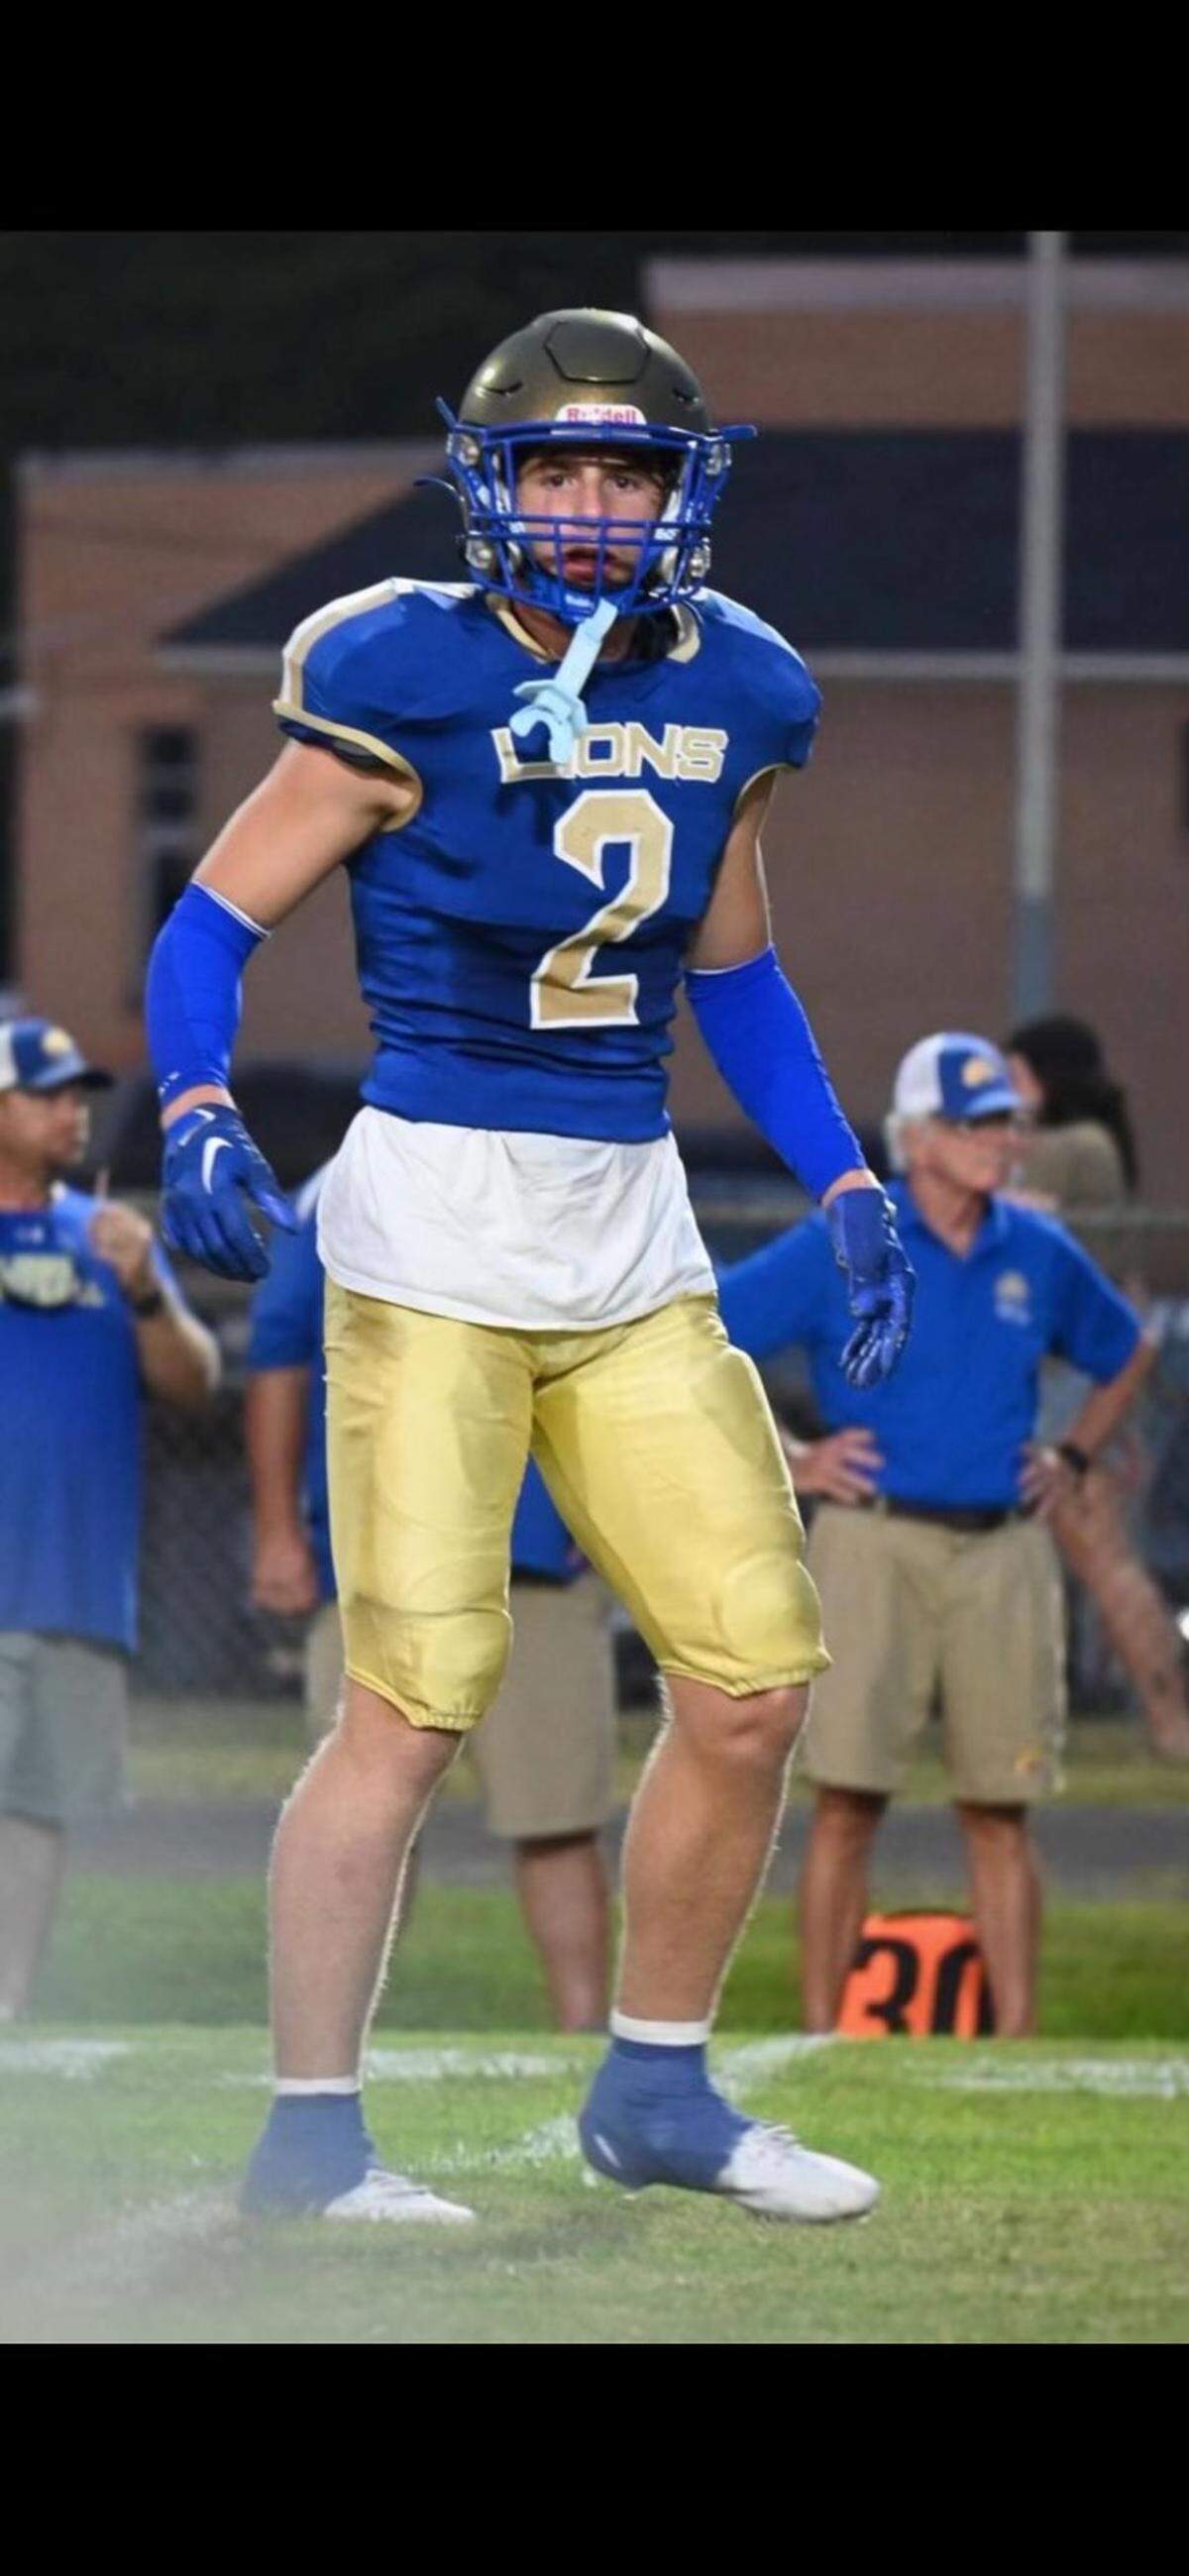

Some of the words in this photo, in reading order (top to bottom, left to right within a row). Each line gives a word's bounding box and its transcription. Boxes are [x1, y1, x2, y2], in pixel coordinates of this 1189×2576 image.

[566, 407, 637, 422] Rdell
[491, 721, 729, 783] LONS
[530, 789, 675, 1029] 2
[852, 1939, 996, 2036] 30
